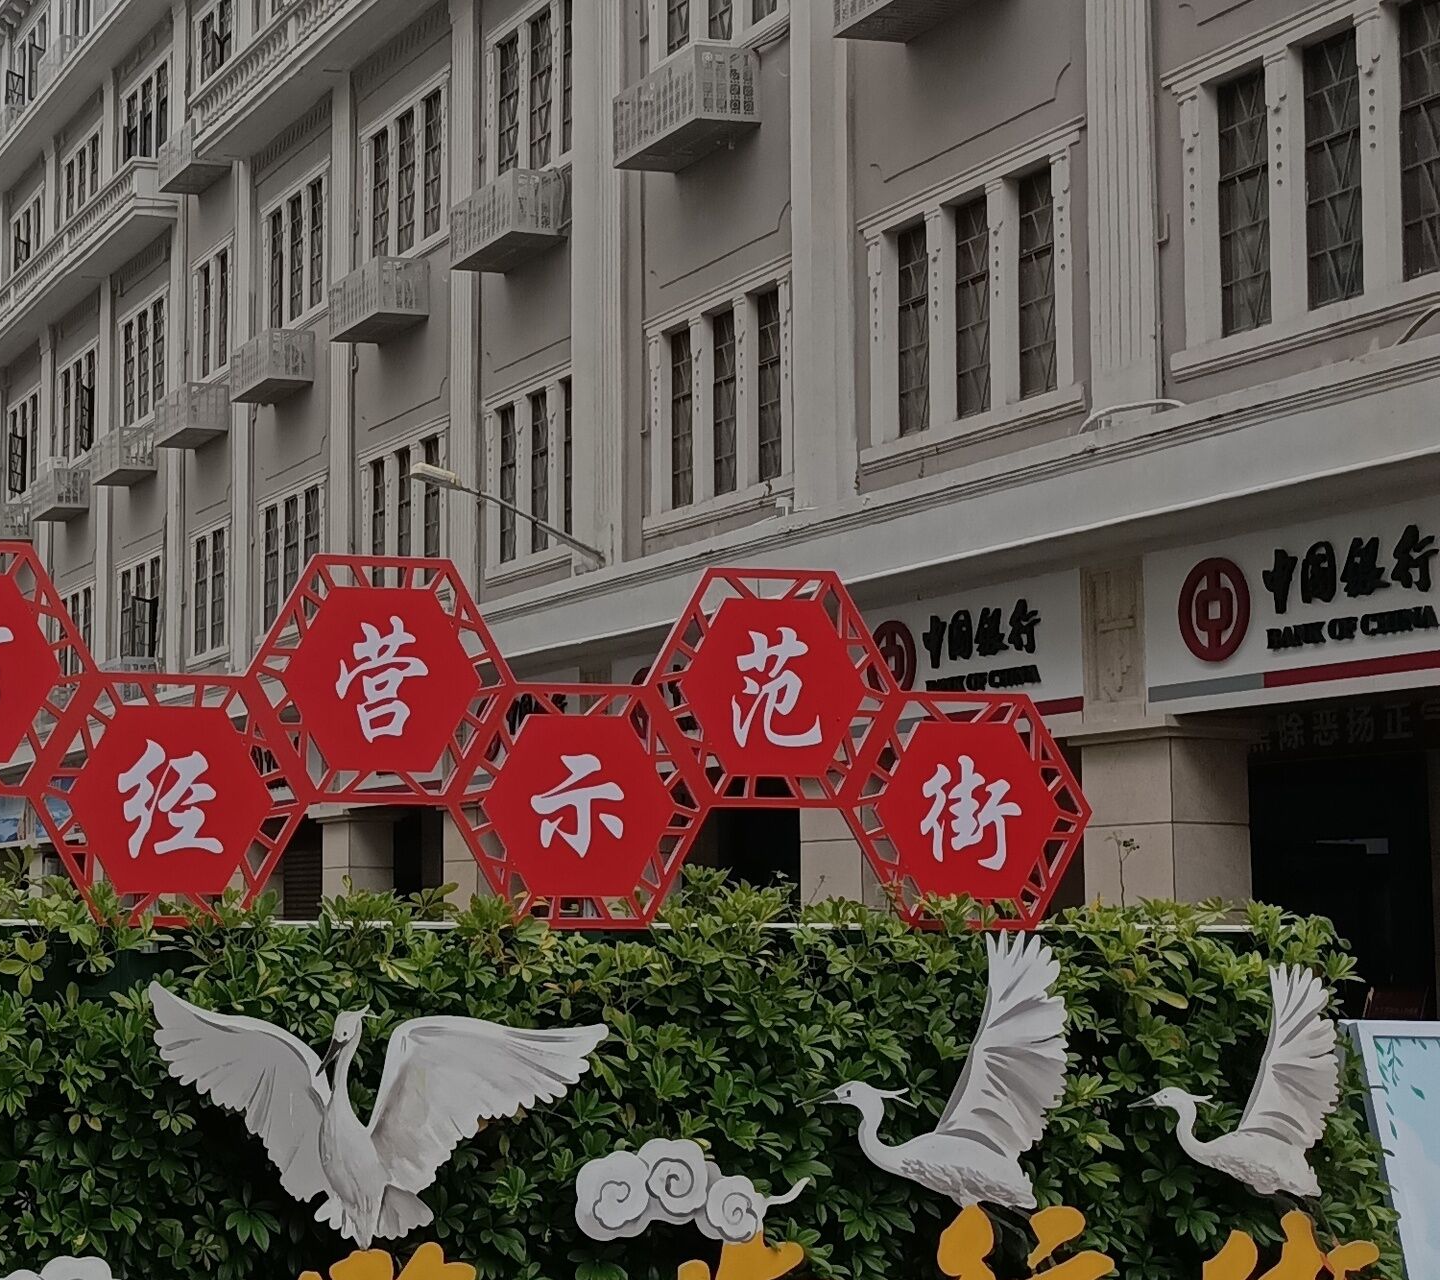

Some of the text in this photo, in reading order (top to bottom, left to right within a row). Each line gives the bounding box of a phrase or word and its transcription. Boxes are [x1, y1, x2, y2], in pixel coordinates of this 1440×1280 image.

[1266, 604, 1440, 650] BANK OF CHINA
